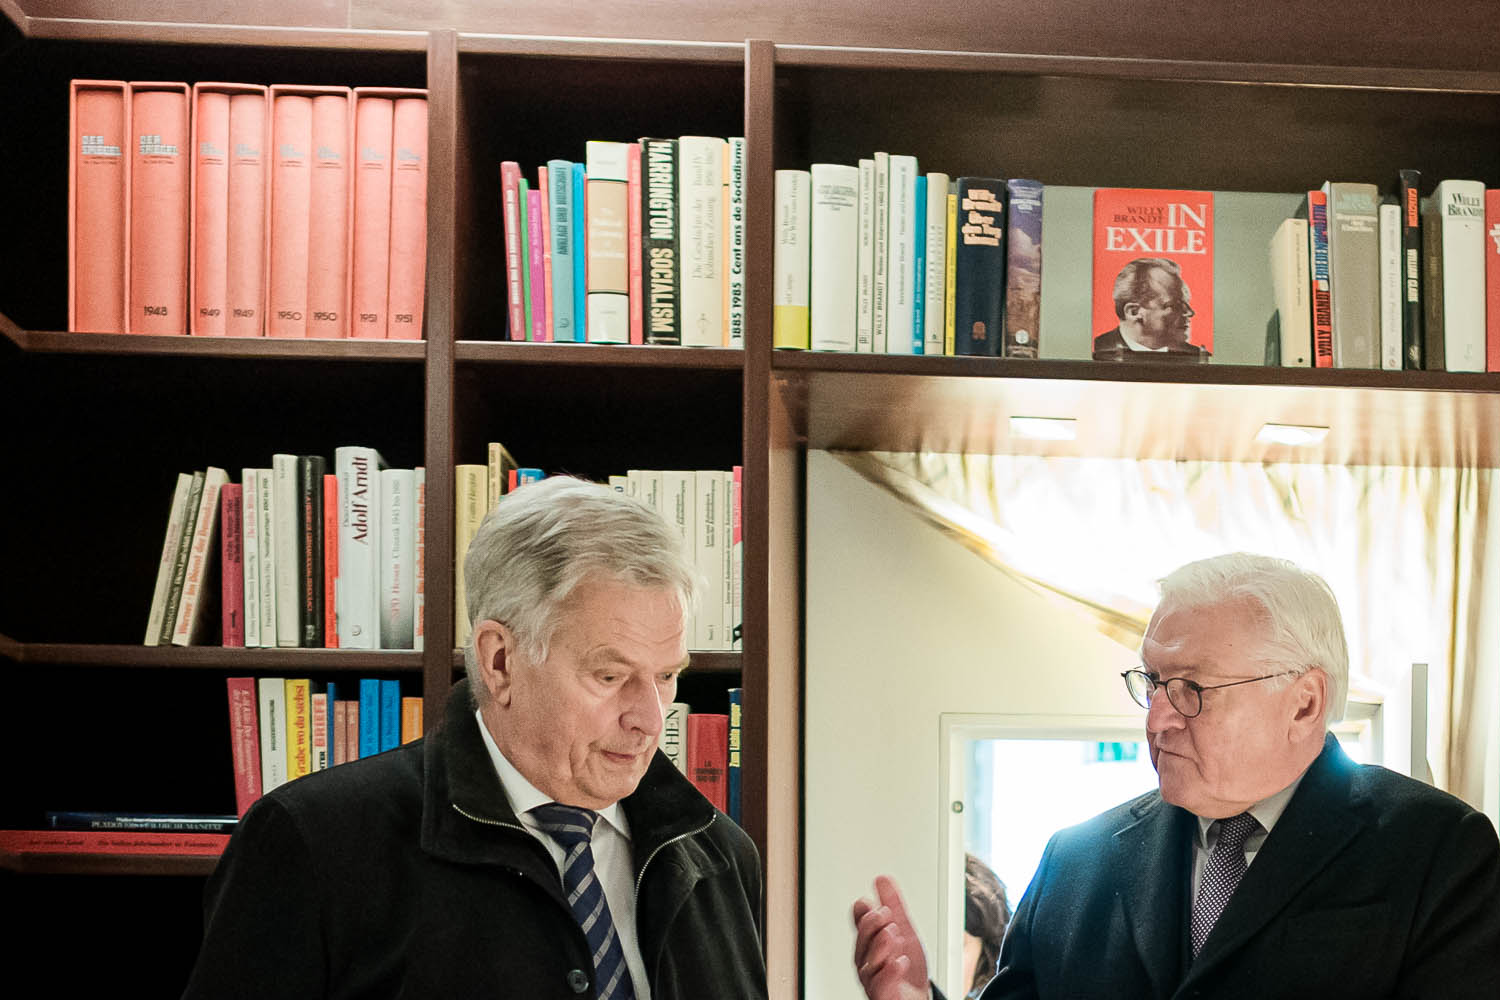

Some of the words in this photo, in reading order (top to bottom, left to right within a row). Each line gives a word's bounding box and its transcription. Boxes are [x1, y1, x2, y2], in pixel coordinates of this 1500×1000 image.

[731, 141, 743, 203] Socialisme
[649, 141, 674, 240] HARRINGTON
[1451, 192, 1481, 204] WILLY
[732, 205, 743, 222] de
[1127, 206, 1164, 215] WILLY
[1167, 203, 1208, 228] IN
[1448, 203, 1484, 216] BRANDT
[1113, 214, 1164, 224] BRANDT
[734, 223, 743, 247] ans
[1106, 227, 1207, 254] EXILE
[732, 249, 743, 274] Cent
[650, 248, 675, 332] SOCIALISM
[732, 282, 743, 307] 1985
[143, 306, 168, 317] 1948
[200, 308, 220, 318] 1949
[233, 309, 254, 318] 1949
[277, 311, 302, 321] 1950
[313, 311, 338, 322] 1950
[360, 313, 378, 323] 1951
[395, 314, 413, 323] 1951
[732, 312, 743, 338] 1885
[1317, 329, 1332, 356] WILLY
[352, 456, 369, 500] Arndt
[352, 500, 368, 545] Adolf
[296, 716, 304, 728] du
[297, 731, 304, 745] wo
